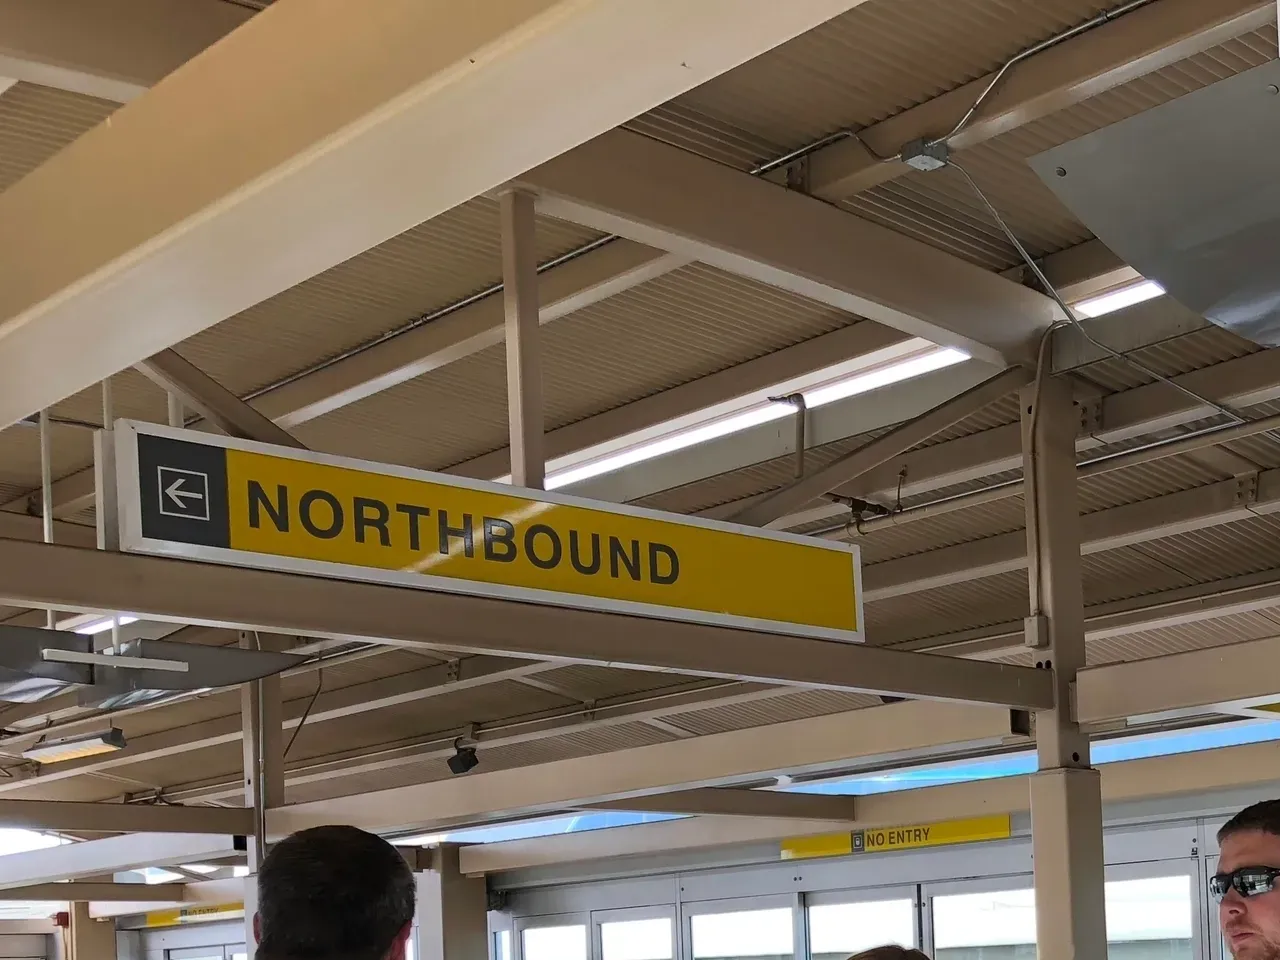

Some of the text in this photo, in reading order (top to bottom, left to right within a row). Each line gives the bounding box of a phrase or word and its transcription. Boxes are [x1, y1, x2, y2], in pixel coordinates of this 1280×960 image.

[247, 480, 680, 584] NORTHBOUND
[866, 827, 930, 847] NO ENTRY
